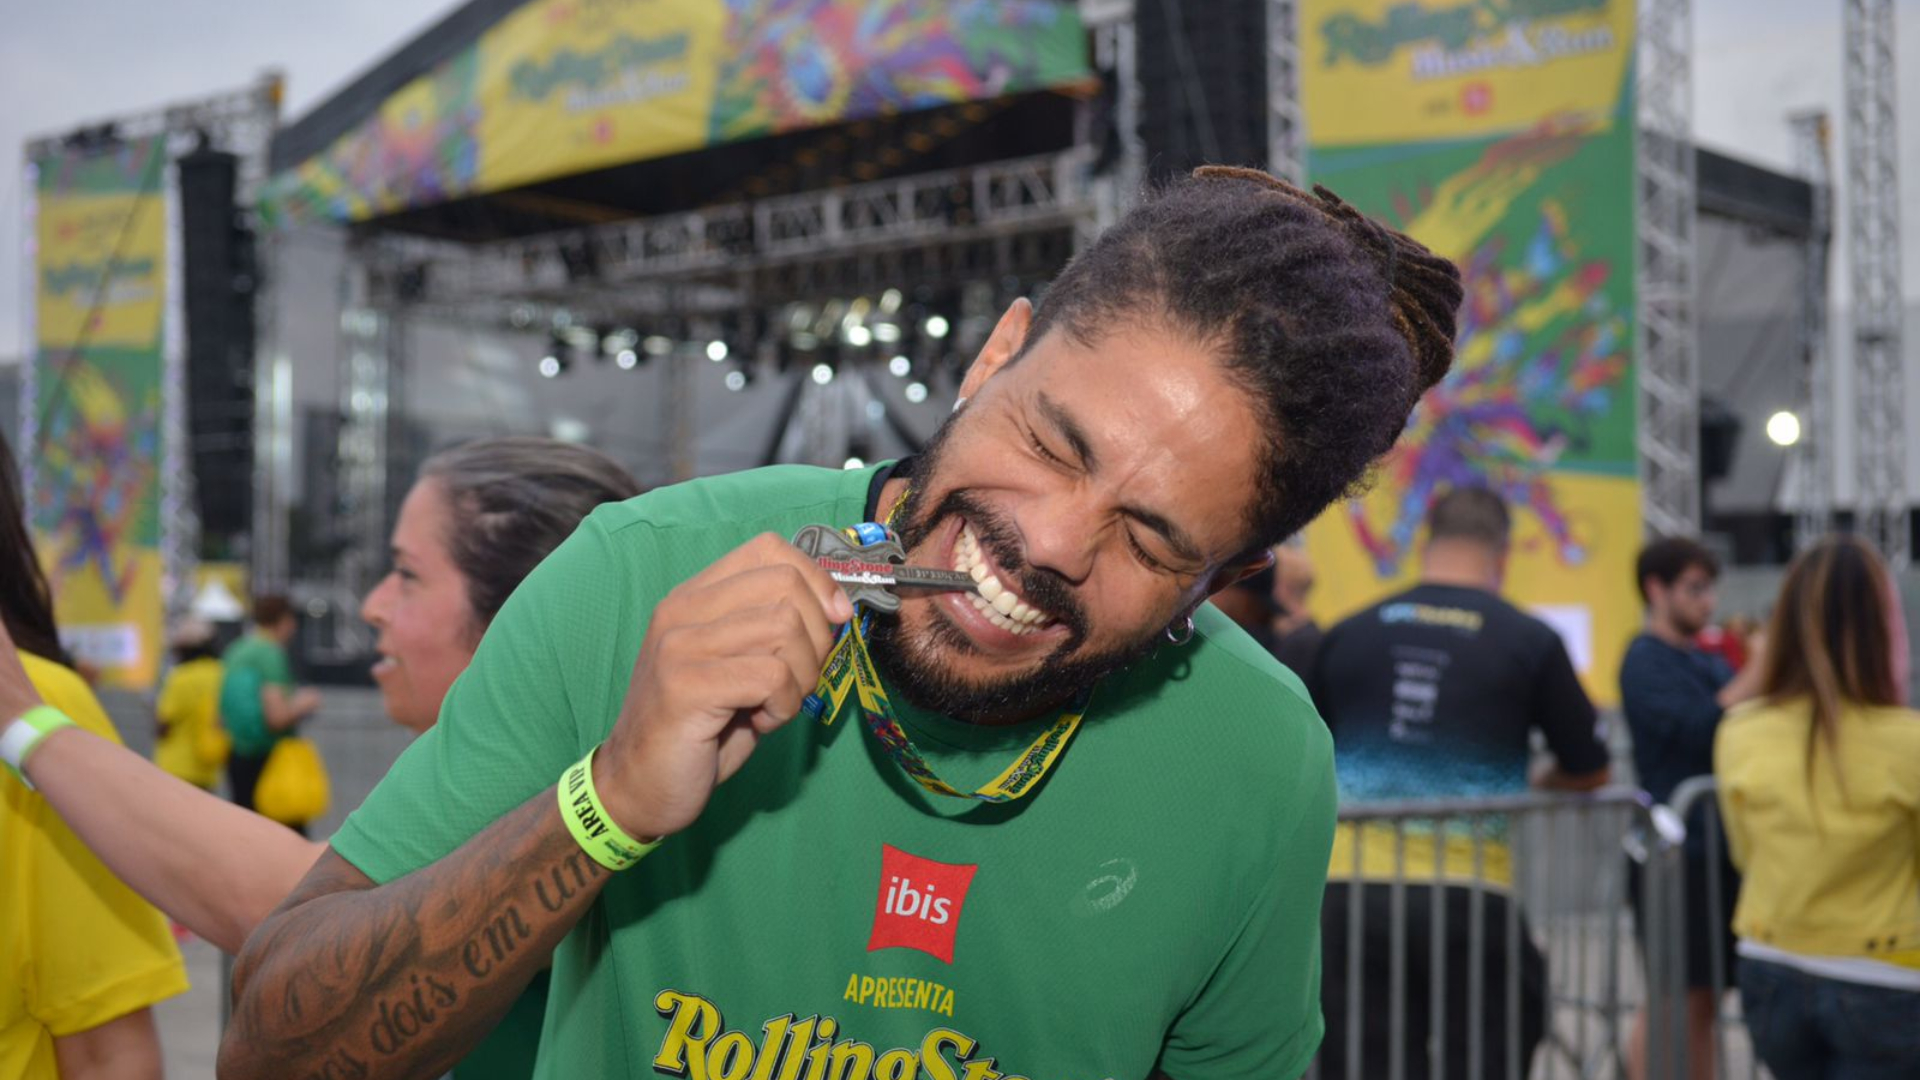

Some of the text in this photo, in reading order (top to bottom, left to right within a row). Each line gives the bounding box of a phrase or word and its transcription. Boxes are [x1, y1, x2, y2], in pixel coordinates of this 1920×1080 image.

[569, 766, 609, 840] ÁREA VIP
[885, 876, 951, 924] ibis
[370, 973, 458, 1056] dois
[462, 904, 530, 979] em
[843, 973, 955, 1017] APRESENTA
